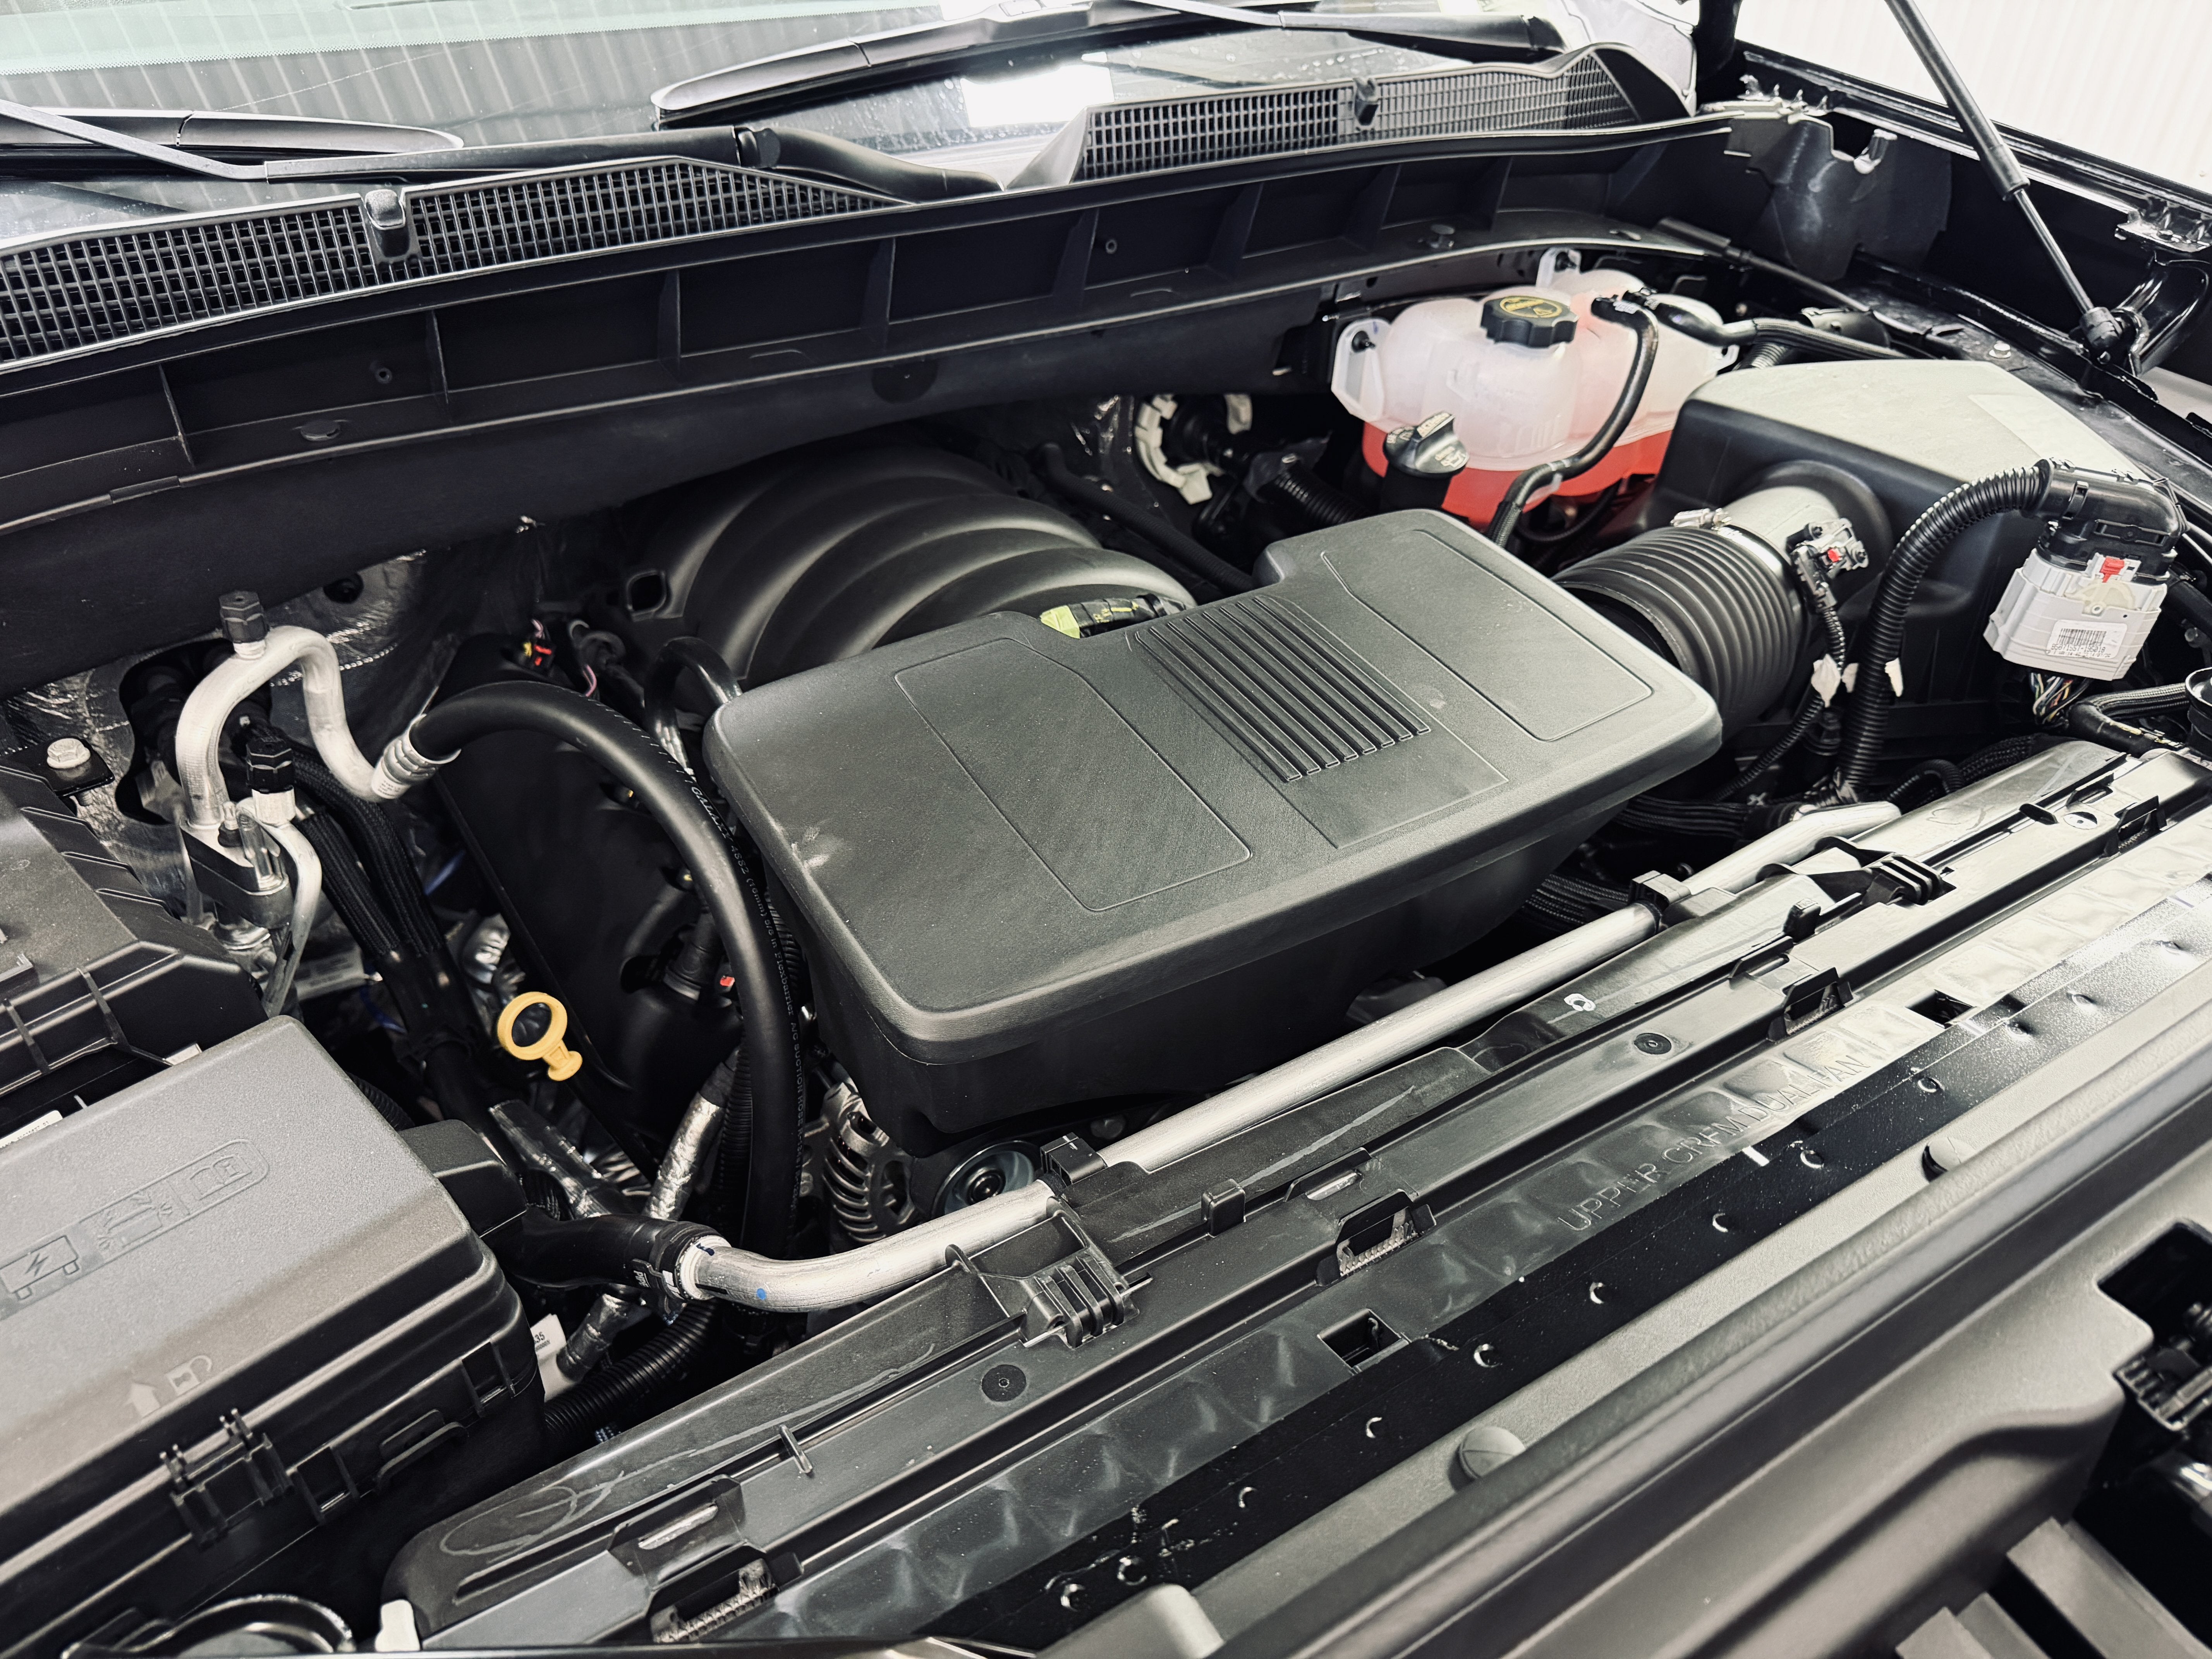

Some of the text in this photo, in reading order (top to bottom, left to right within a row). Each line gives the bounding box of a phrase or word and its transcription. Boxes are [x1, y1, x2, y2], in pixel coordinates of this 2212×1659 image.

[691, 787, 734, 842] GALAXY
[746, 878, 767, 917] (16mm)
[775, 951, 794, 1016] Flexbarrier
[794, 1043, 804, 1093] SUCTION
[1557, 1163, 1657, 1231] UPPER
[1661, 1116, 1751, 1164] CRFM
[1737, 1084, 1821, 1122] DUAL
